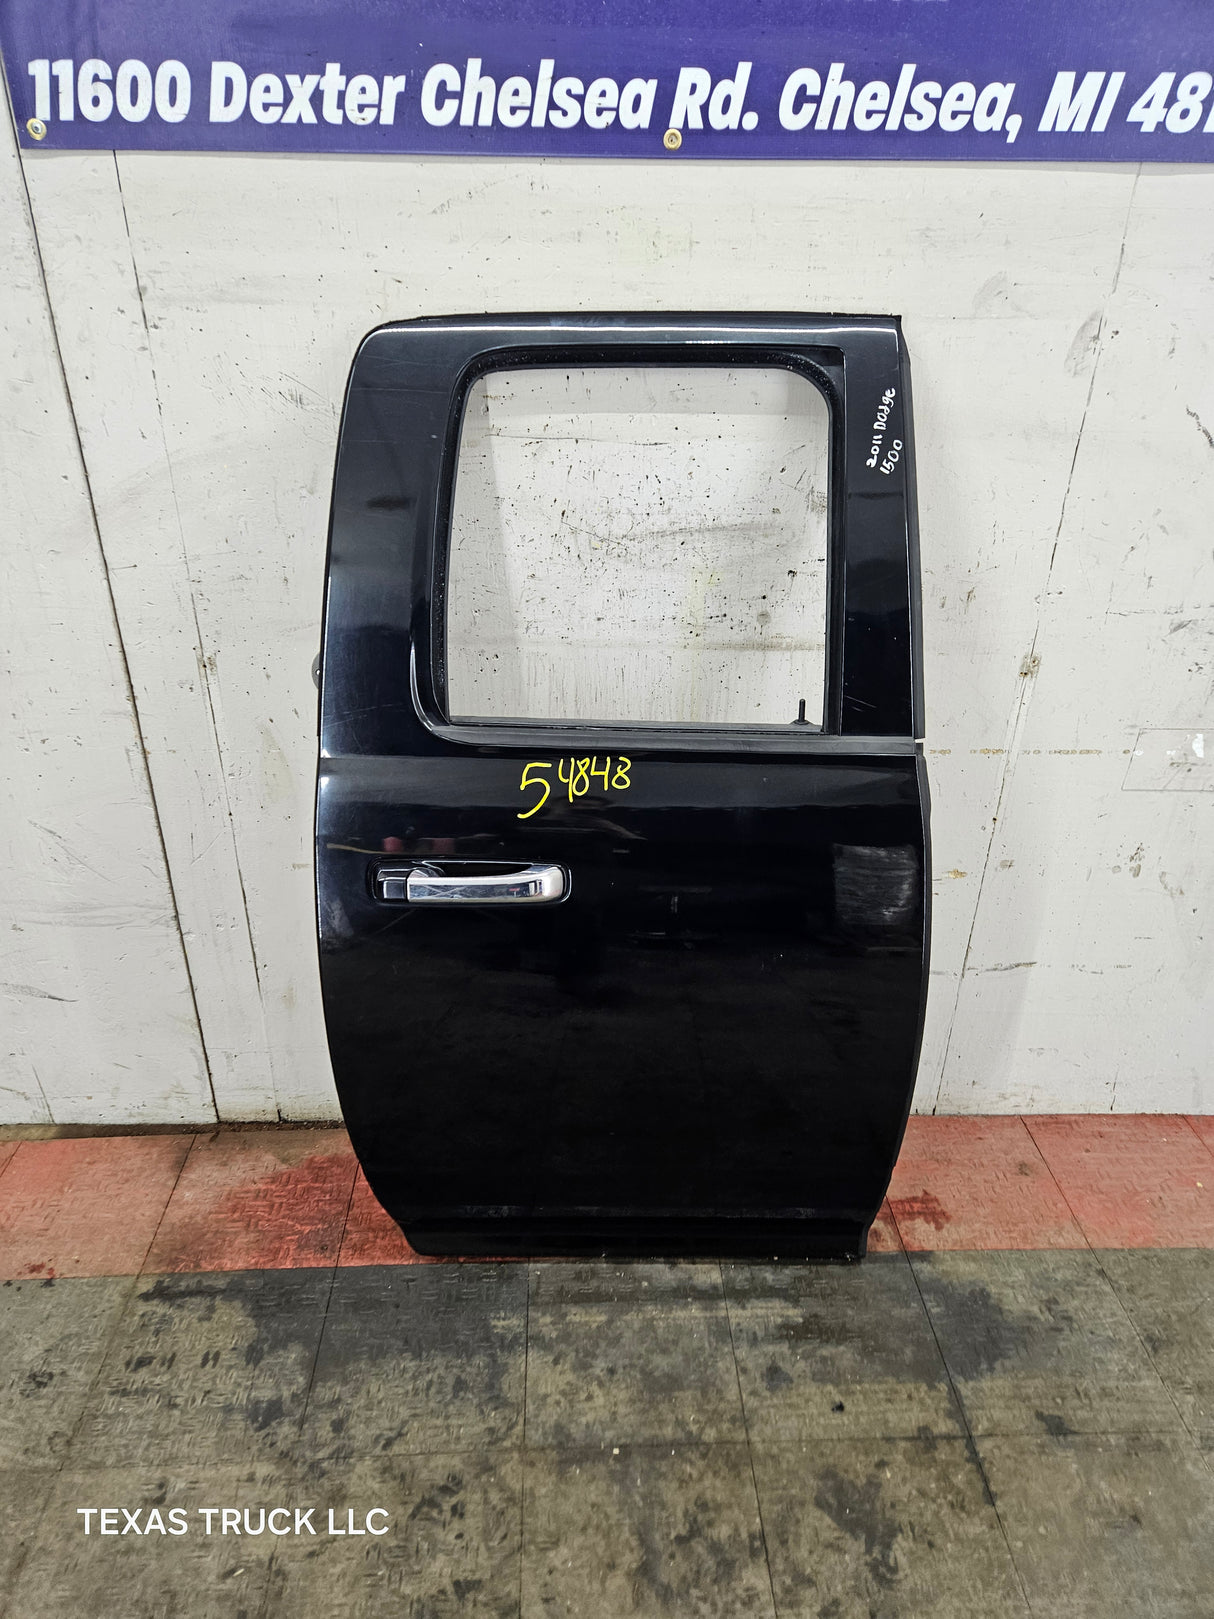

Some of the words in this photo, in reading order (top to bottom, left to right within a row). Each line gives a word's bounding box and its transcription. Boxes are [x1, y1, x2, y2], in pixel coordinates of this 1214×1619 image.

[27, 58, 192, 123] 11600
[208, 60, 406, 126] Dexter
[420, 57, 658, 130] Chelsea
[668, 61, 759, 131] Rd.
[778, 62, 1023, 144] Chelsea,
[1037, 71, 1126, 132] MI
[873, 387, 896, 430] Dodge
[865, 434, 883, 468] 2011
[879, 439, 903, 475] 1500
